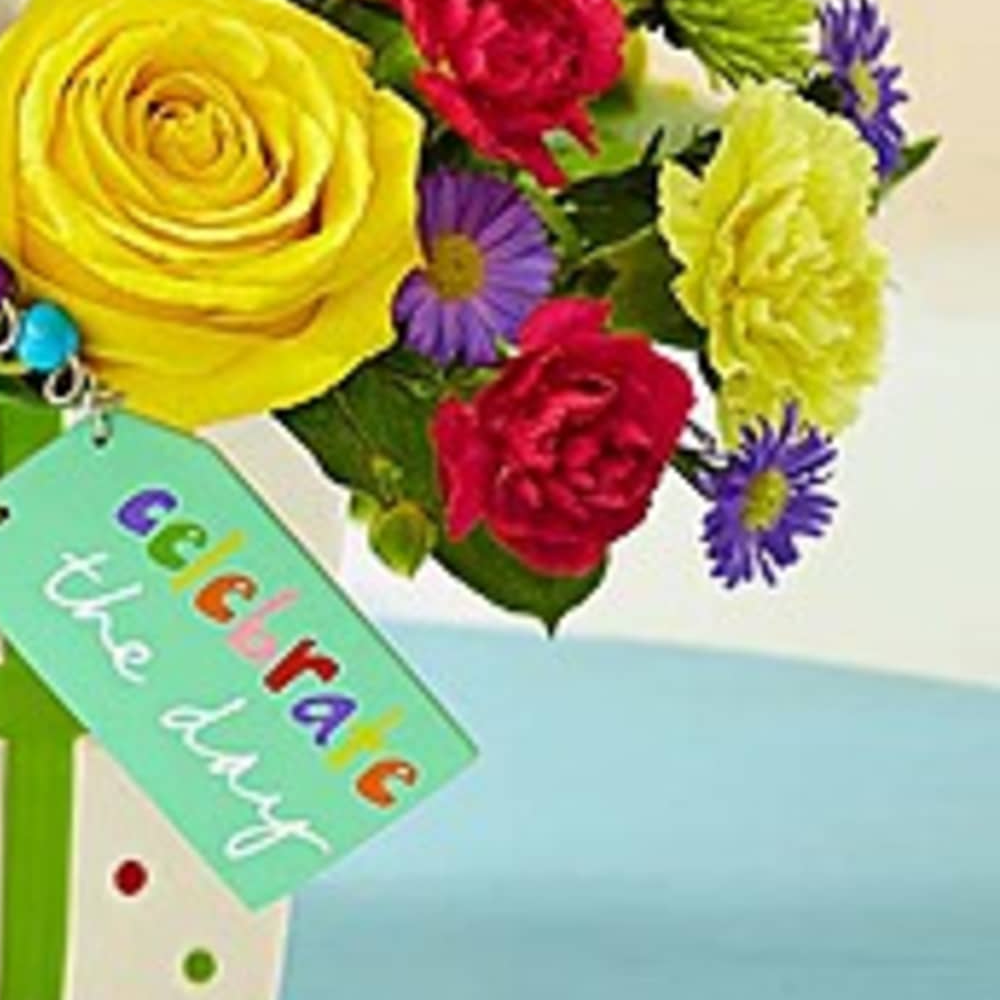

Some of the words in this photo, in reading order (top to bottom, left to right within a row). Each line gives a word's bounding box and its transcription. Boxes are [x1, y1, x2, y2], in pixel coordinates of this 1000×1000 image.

[43, 551, 152, 684] the
[159, 698, 333, 860] day
[116, 489, 418, 807] celebrate
